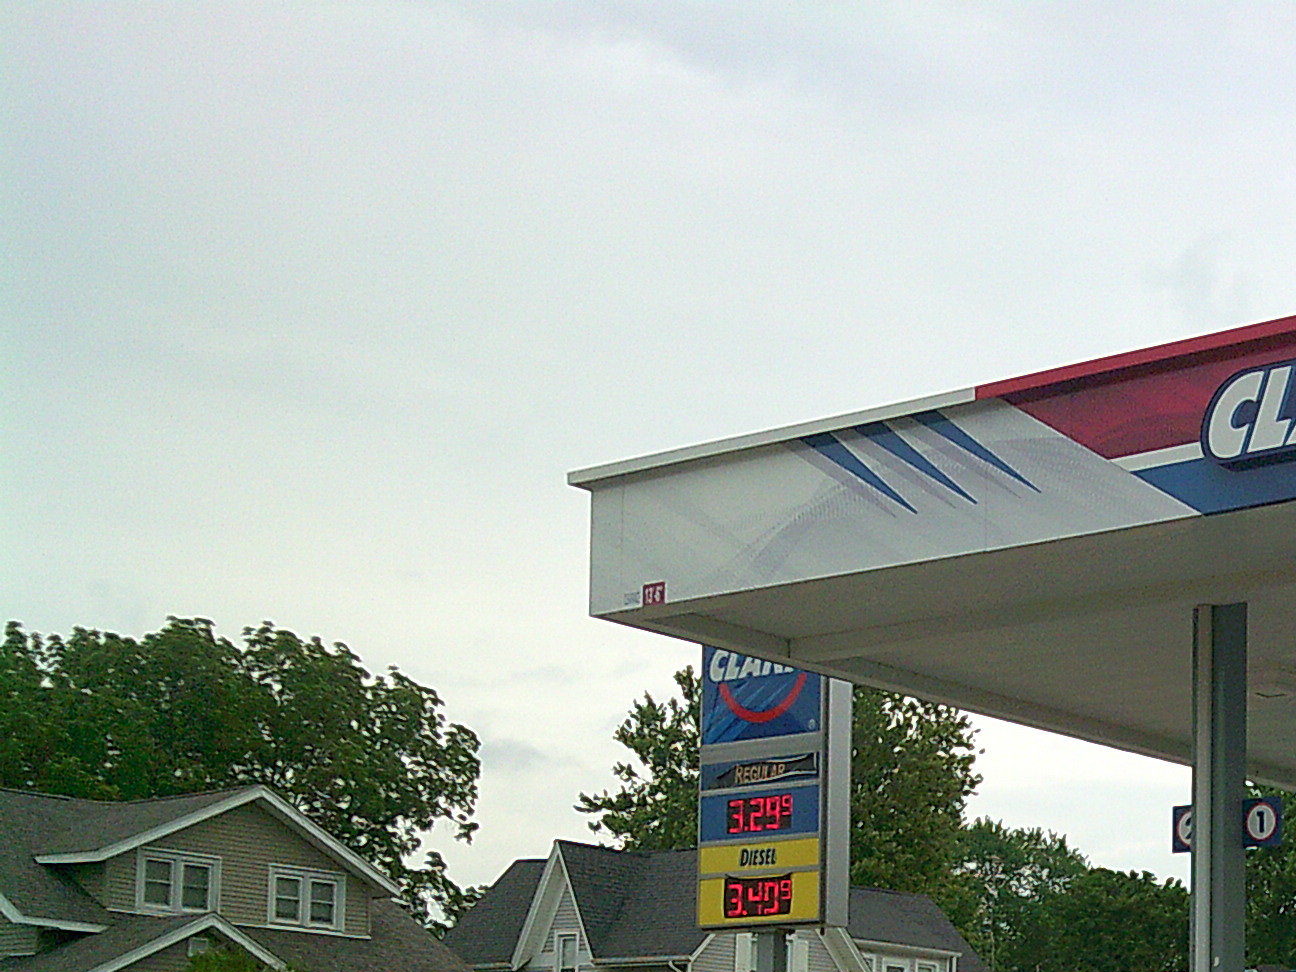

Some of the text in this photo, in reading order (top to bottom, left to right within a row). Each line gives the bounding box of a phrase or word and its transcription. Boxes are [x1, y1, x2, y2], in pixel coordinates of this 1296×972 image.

[709, 649, 795, 683] CLA
[1256, 810, 1265, 834] 1
[740, 848, 776, 867] DIESEL
